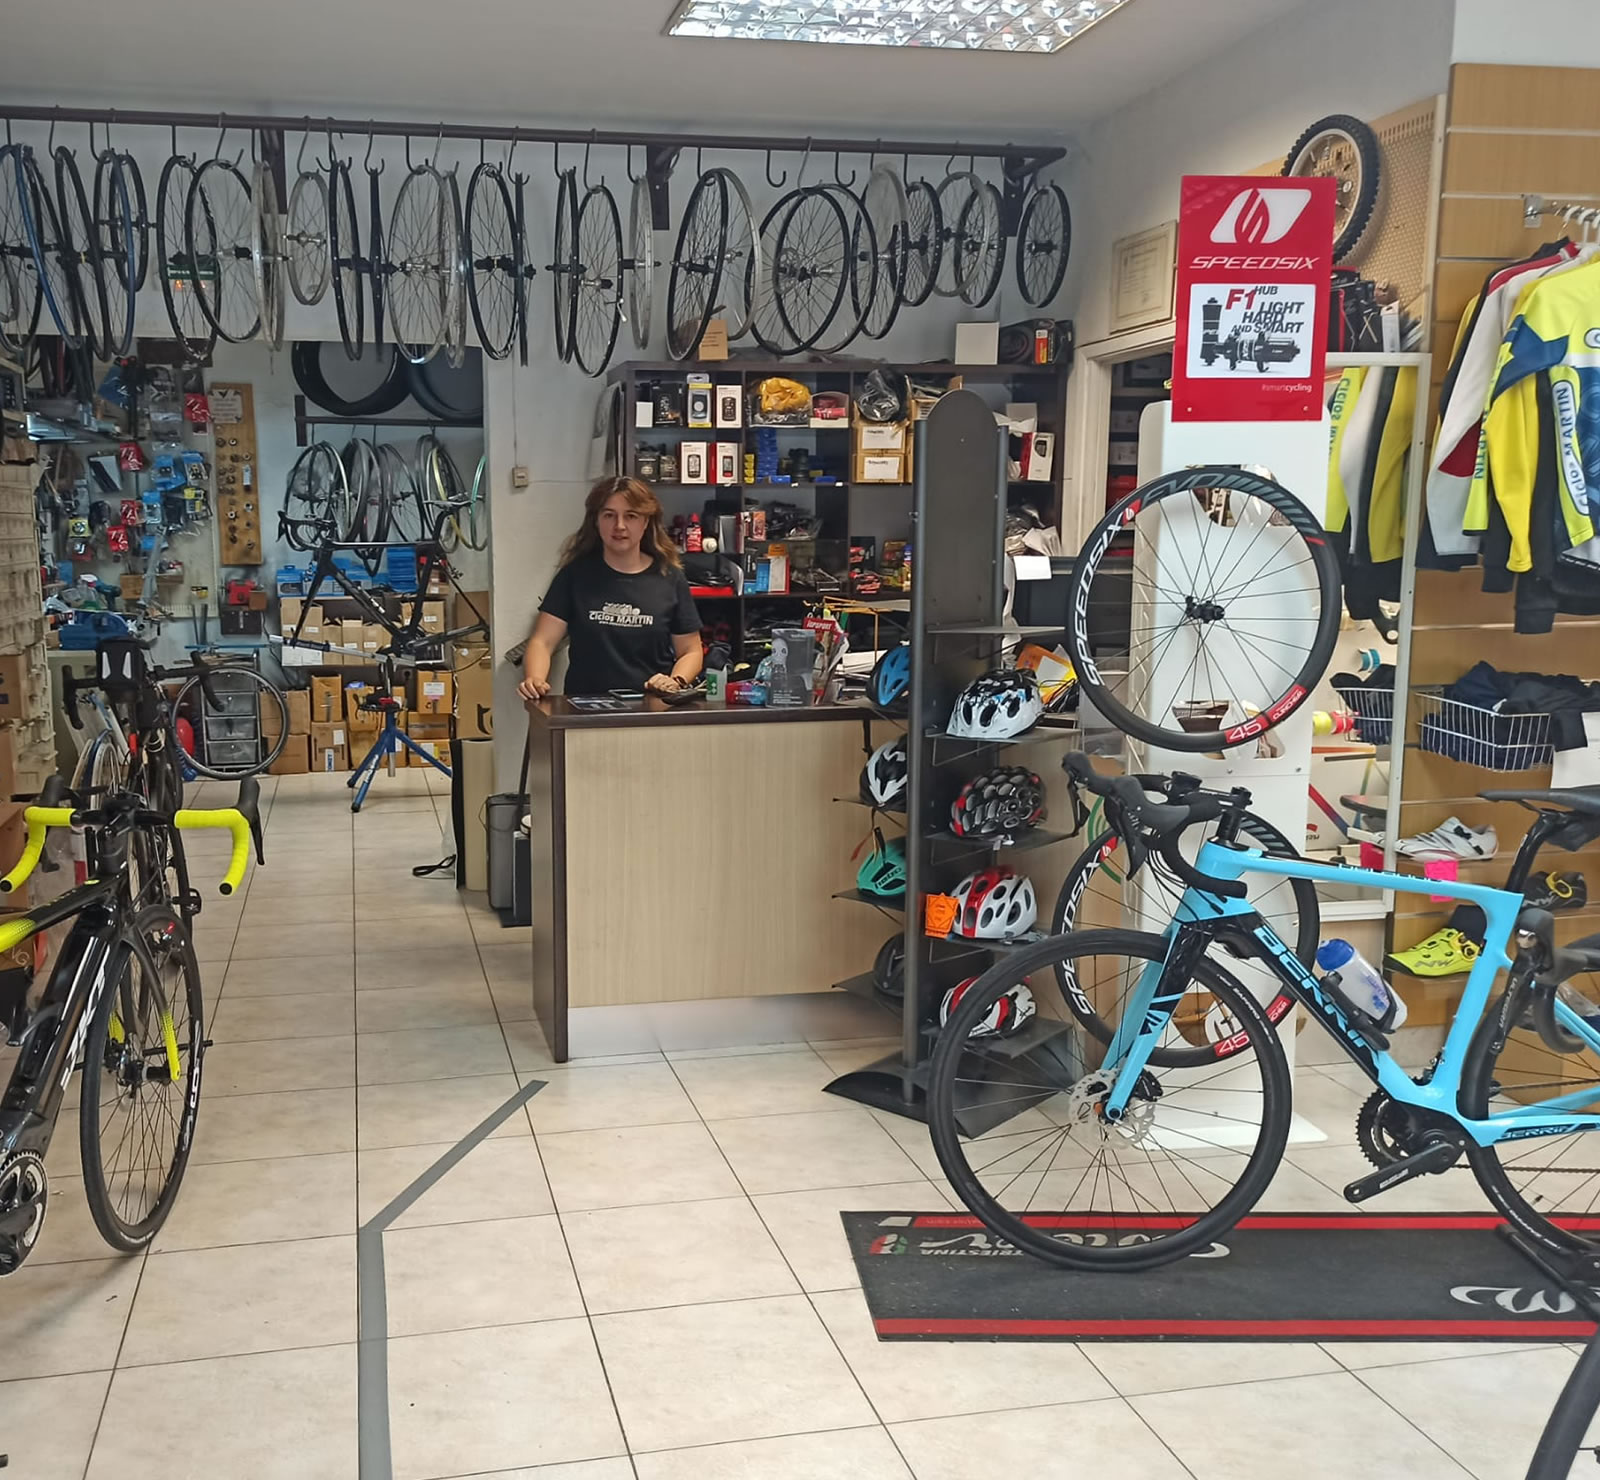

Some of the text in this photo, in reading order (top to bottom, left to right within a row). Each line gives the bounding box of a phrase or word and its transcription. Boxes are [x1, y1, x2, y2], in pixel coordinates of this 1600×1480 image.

[1189, 256, 1320, 271] SPEEDSIX
[1255, 285, 1278, 295] HUB
[1225, 288, 1257, 310] F1
[1259, 301, 1305, 314] LIGHT
[1241, 311, 1285, 324] HARD
[1231, 324, 1252, 333] AND
[1253, 321, 1305, 333] SMART
[1555, 387, 1575, 457] MARTIN
[1075, 511, 1124, 687] SPEEDSIX
[616, 614, 654, 625] MARTIN
[1229, 718, 1262, 740] 45
[1218, 1029, 1250, 1054] 45
